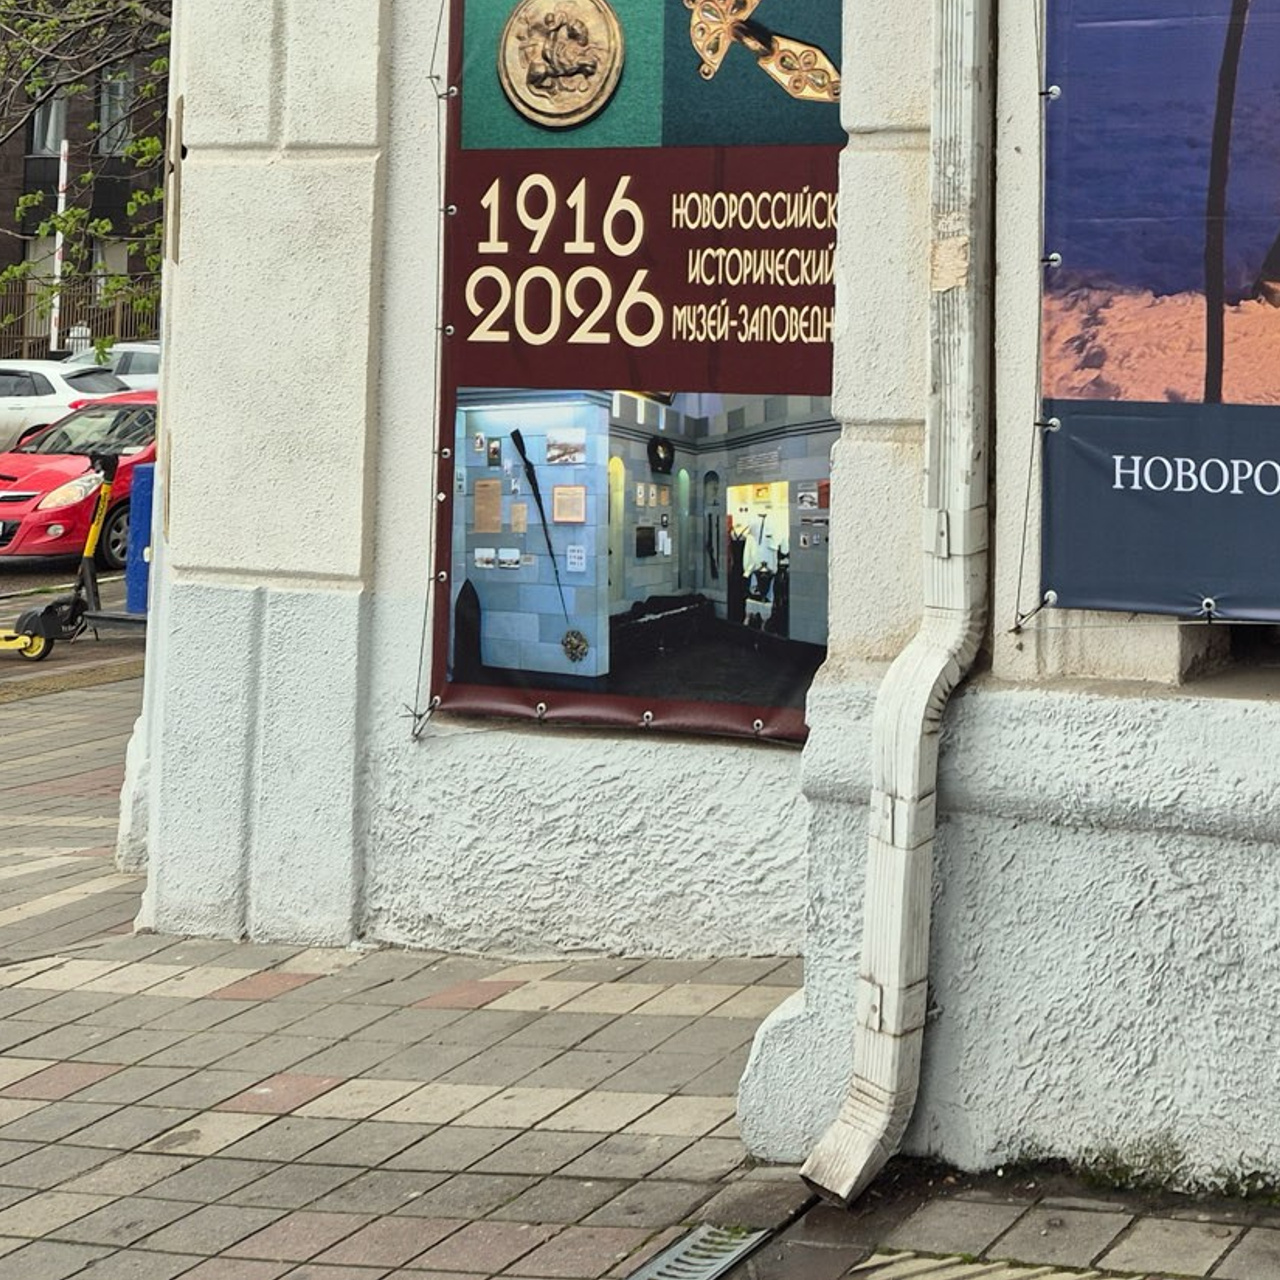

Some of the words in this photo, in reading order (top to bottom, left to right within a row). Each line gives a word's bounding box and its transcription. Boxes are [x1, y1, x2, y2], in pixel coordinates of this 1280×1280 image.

[477, 173, 644, 257] 1916
[672, 186, 838, 230] НОВОРОССИЙСК
[688, 242, 836, 286] ИСТОРИЧЕСКИЙ
[465, 265, 664, 348] 2026
[672, 298, 835, 343] МУЗЕЙ-ЗАПОВЕДН
